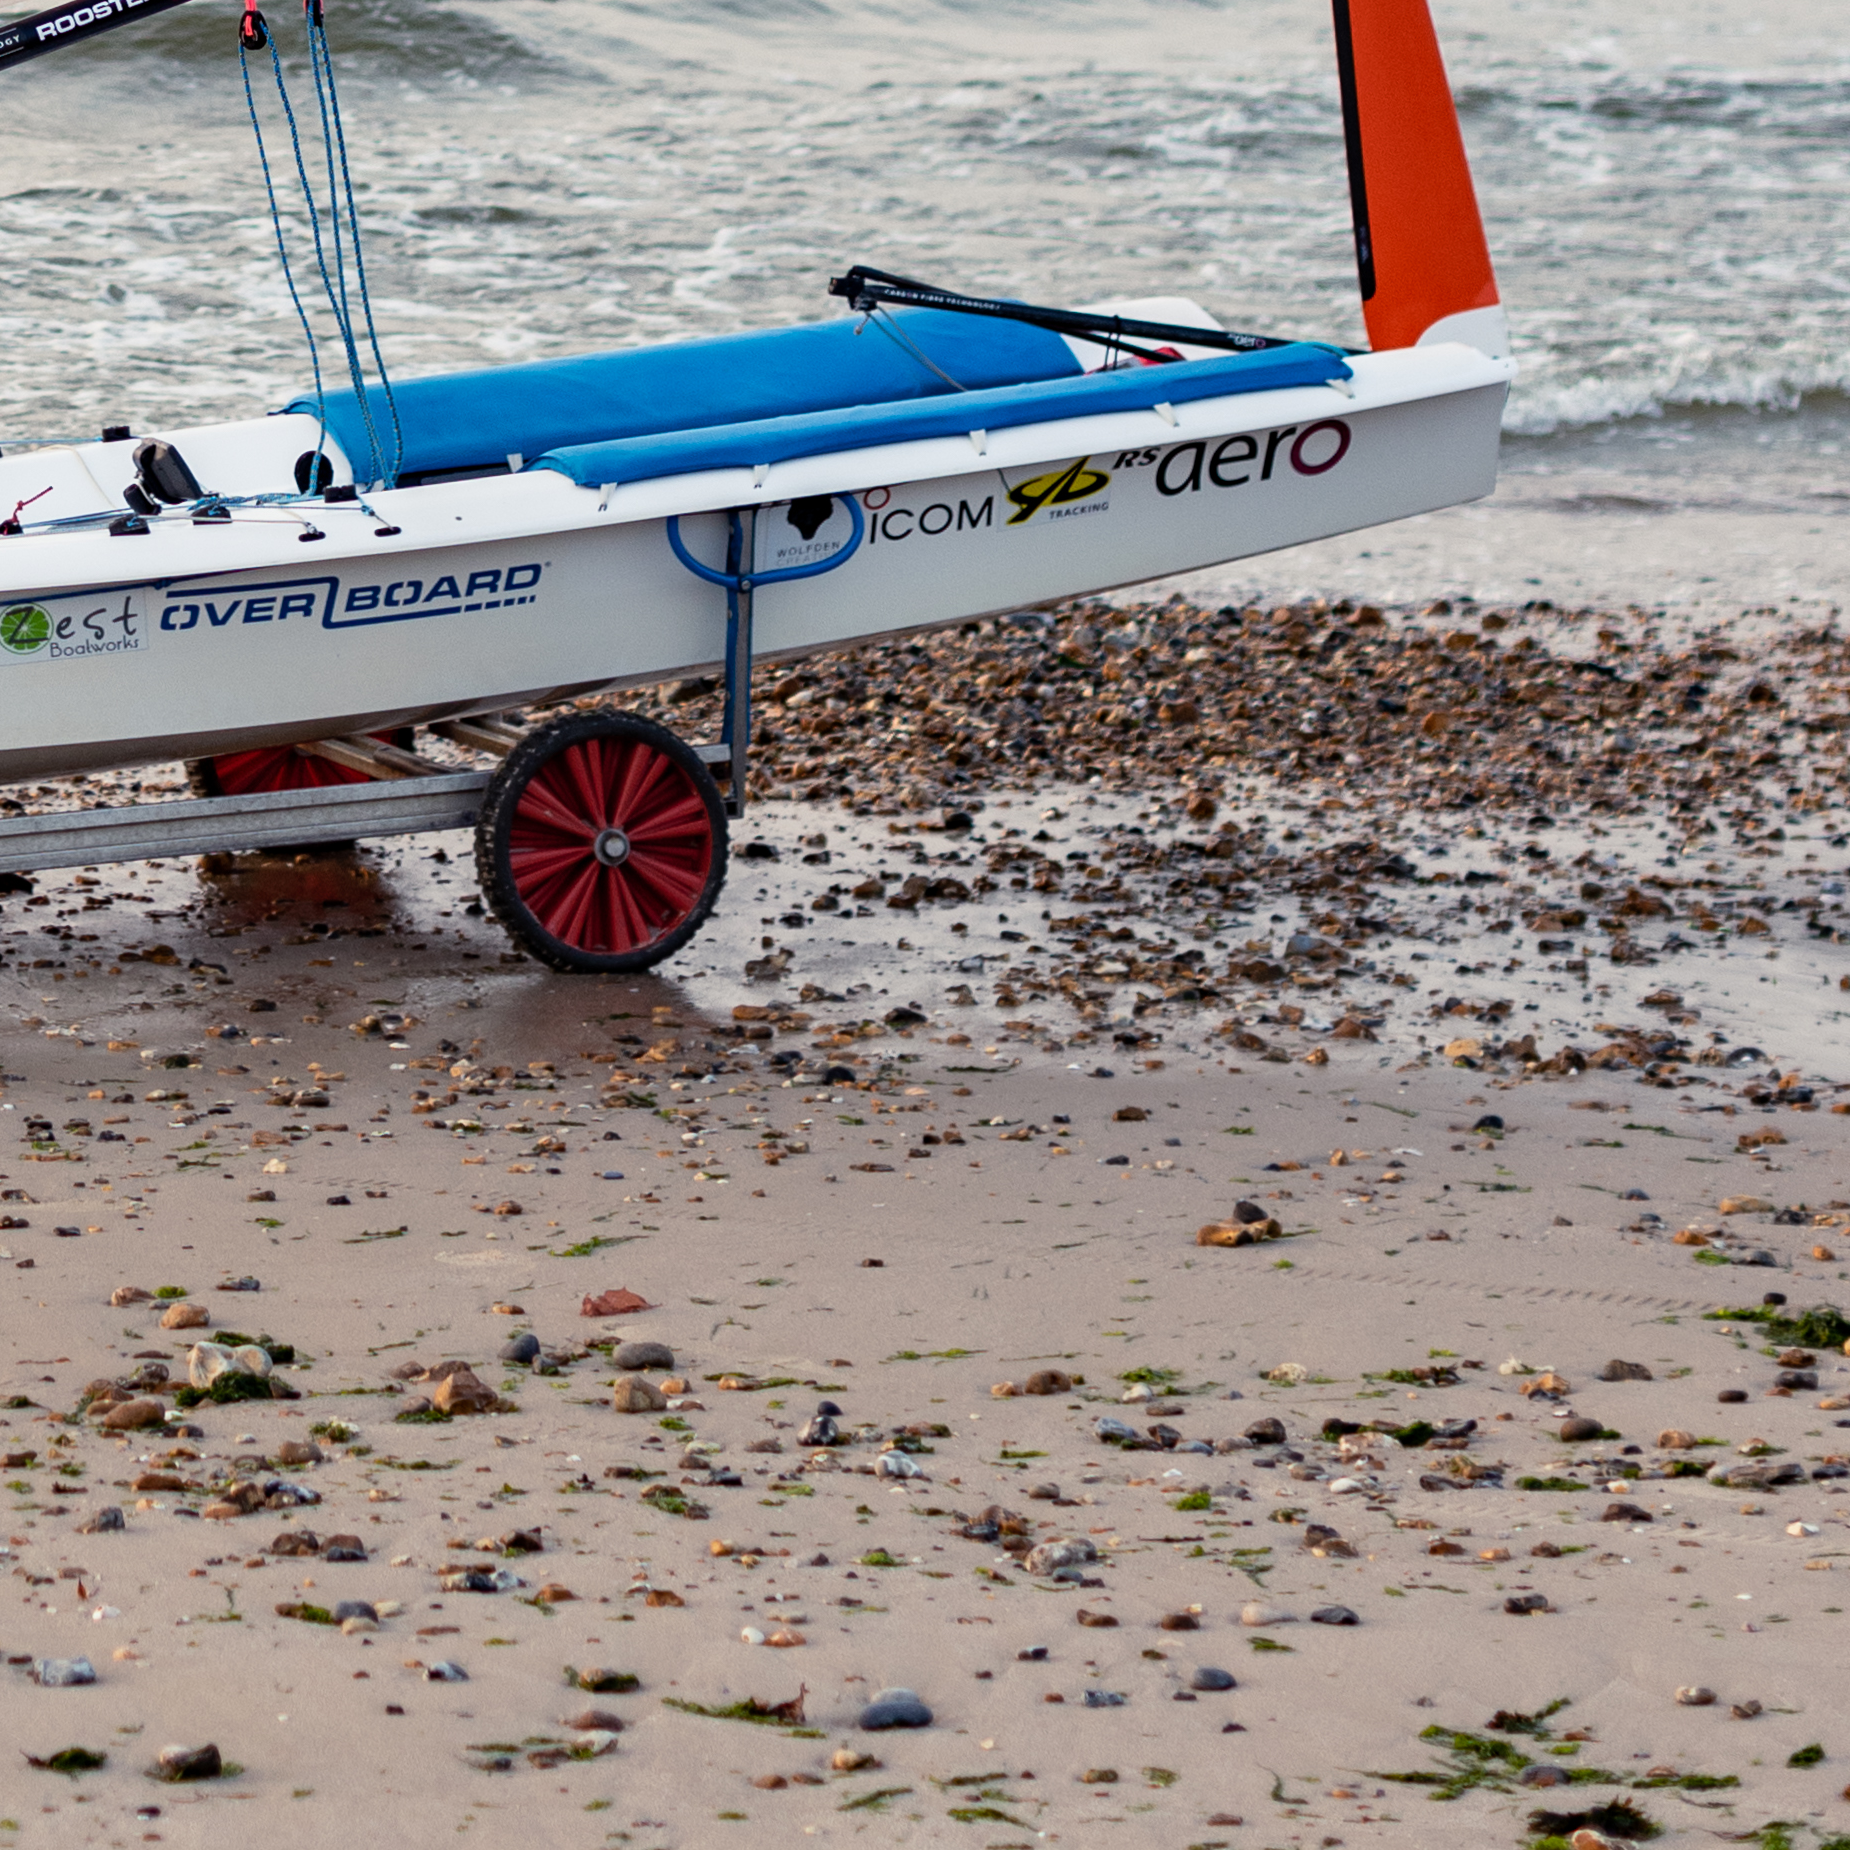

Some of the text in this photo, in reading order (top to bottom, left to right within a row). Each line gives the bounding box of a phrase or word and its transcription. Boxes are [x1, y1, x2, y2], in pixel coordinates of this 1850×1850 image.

[1112, 419, 1352, 496] RS aero
[1050, 501, 1109, 519] TRACKING
[777, 541, 840, 558] WOLFDEN
[6, 595, 139, 644] Zest
[50, 634, 140, 658] Boatworks
